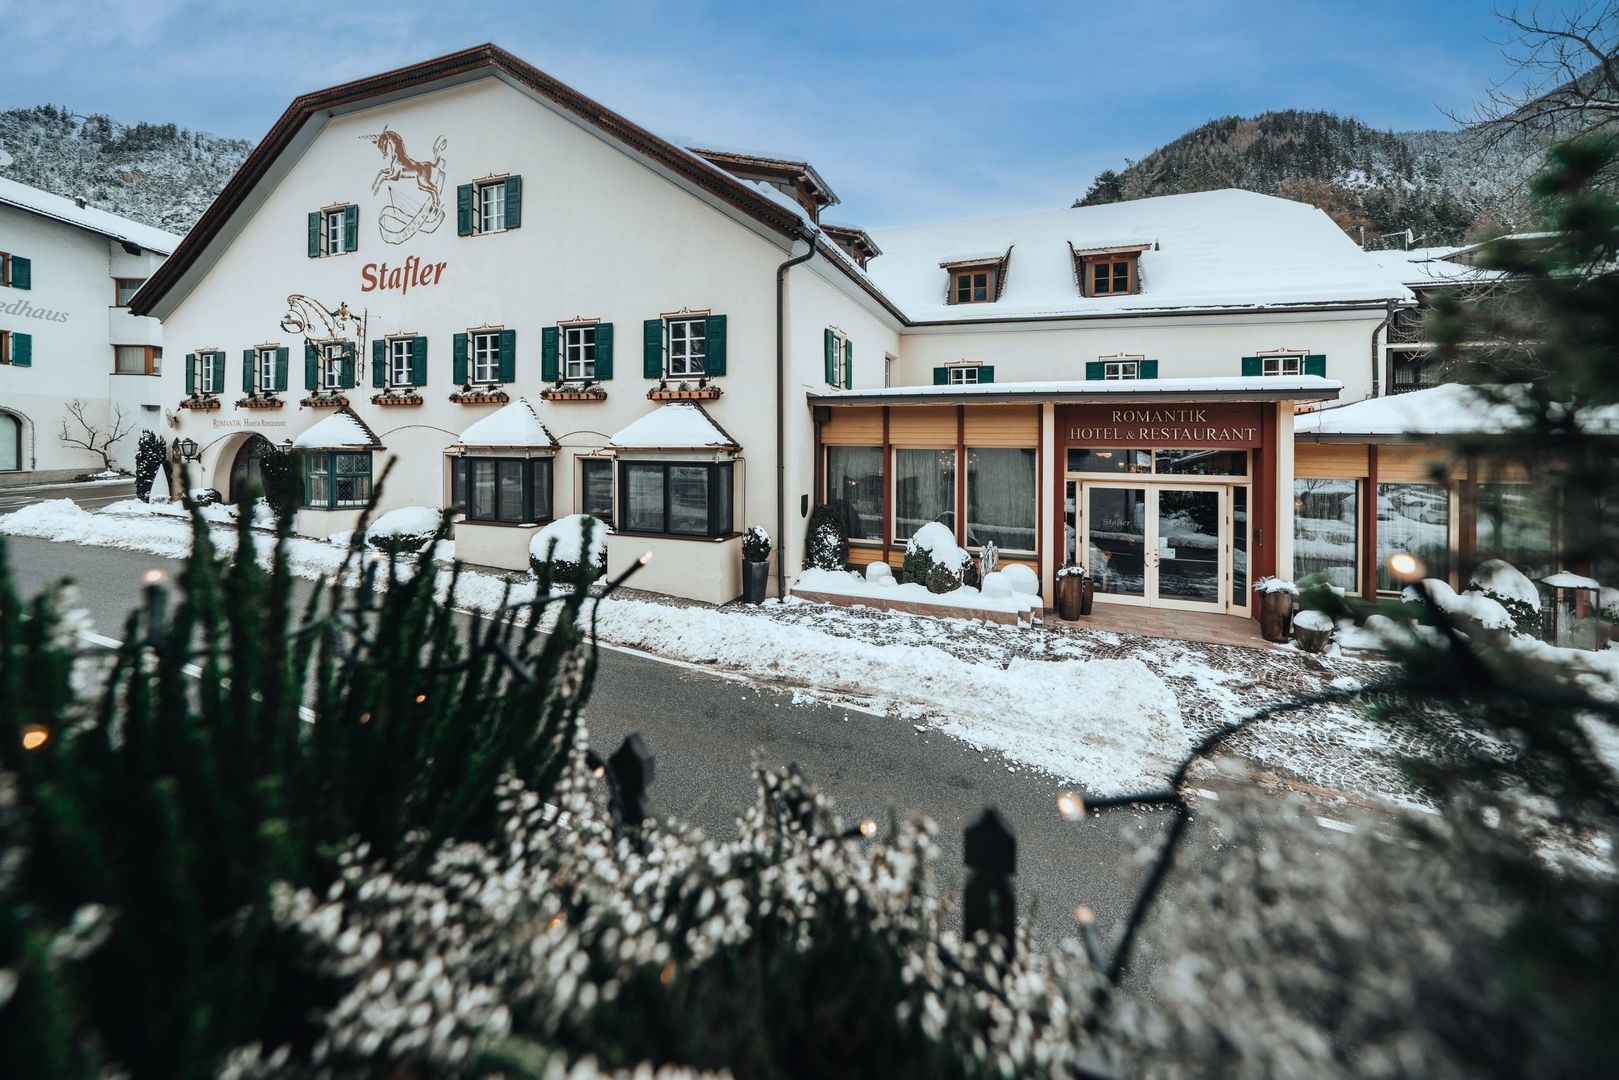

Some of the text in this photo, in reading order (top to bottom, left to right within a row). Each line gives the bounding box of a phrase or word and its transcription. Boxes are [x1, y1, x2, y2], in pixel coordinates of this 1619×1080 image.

[361, 255, 447, 295] Stafler
[1112, 410, 1207, 422] ROMANTIK
[1070, 427, 1256, 441] HOTEL & RESTAURANT
